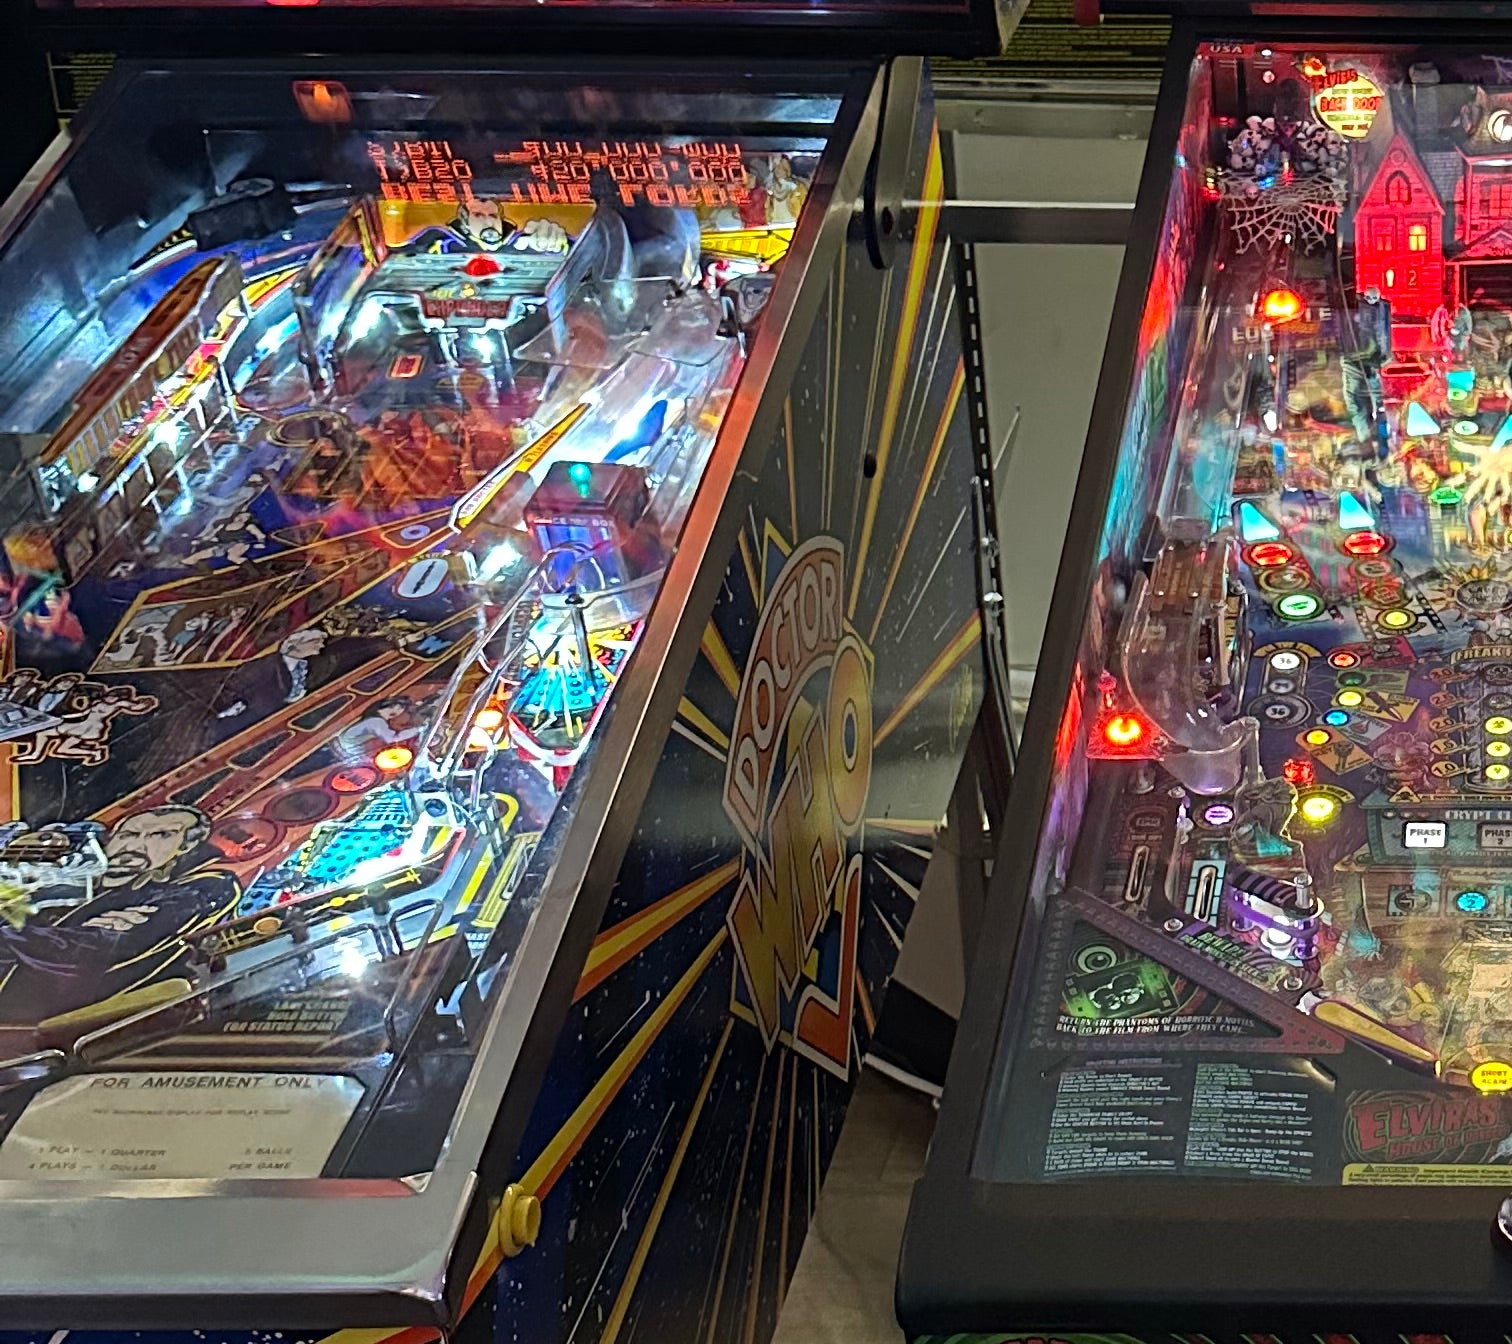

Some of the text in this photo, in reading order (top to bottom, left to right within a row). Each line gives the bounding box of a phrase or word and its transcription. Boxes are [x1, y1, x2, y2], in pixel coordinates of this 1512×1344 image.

[1208, 43, 1243, 55] USA
[1445, 810, 1493, 821] CRYPT
[1409, 828, 1442, 837] PHASE
[90, 1076, 328, 1089] FOR AMUSEMENT ONLY
[111, 1147, 167, 1157] QUARTER
[1388, 1138, 1440, 1161] HOUSE
